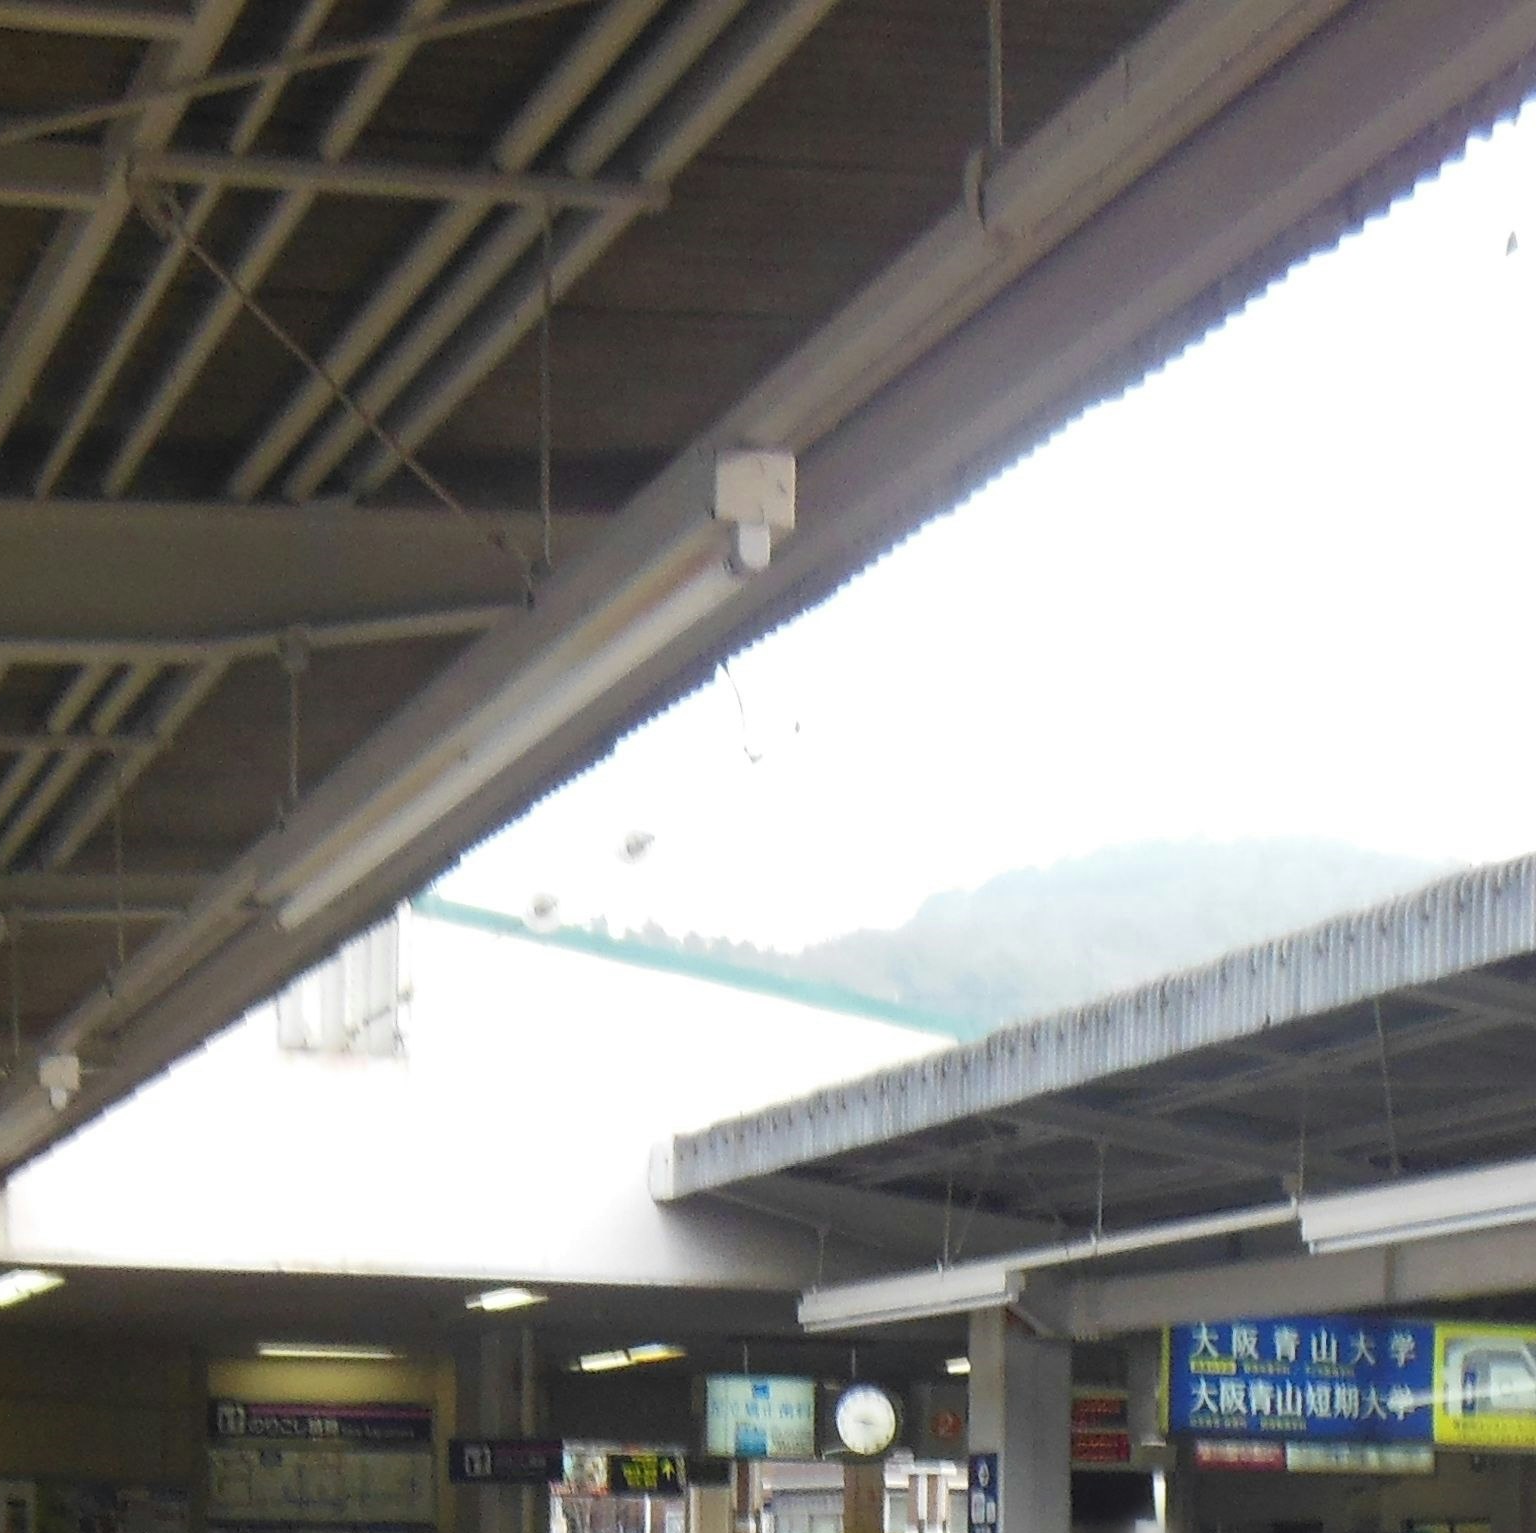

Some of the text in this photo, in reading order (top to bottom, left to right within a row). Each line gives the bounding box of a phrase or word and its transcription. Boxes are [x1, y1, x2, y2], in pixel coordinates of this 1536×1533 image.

[1190, 1321, 1415, 1368] 大阪青山大学
[1190, 1376, 1415, 1420] 大阪青山短期大学
